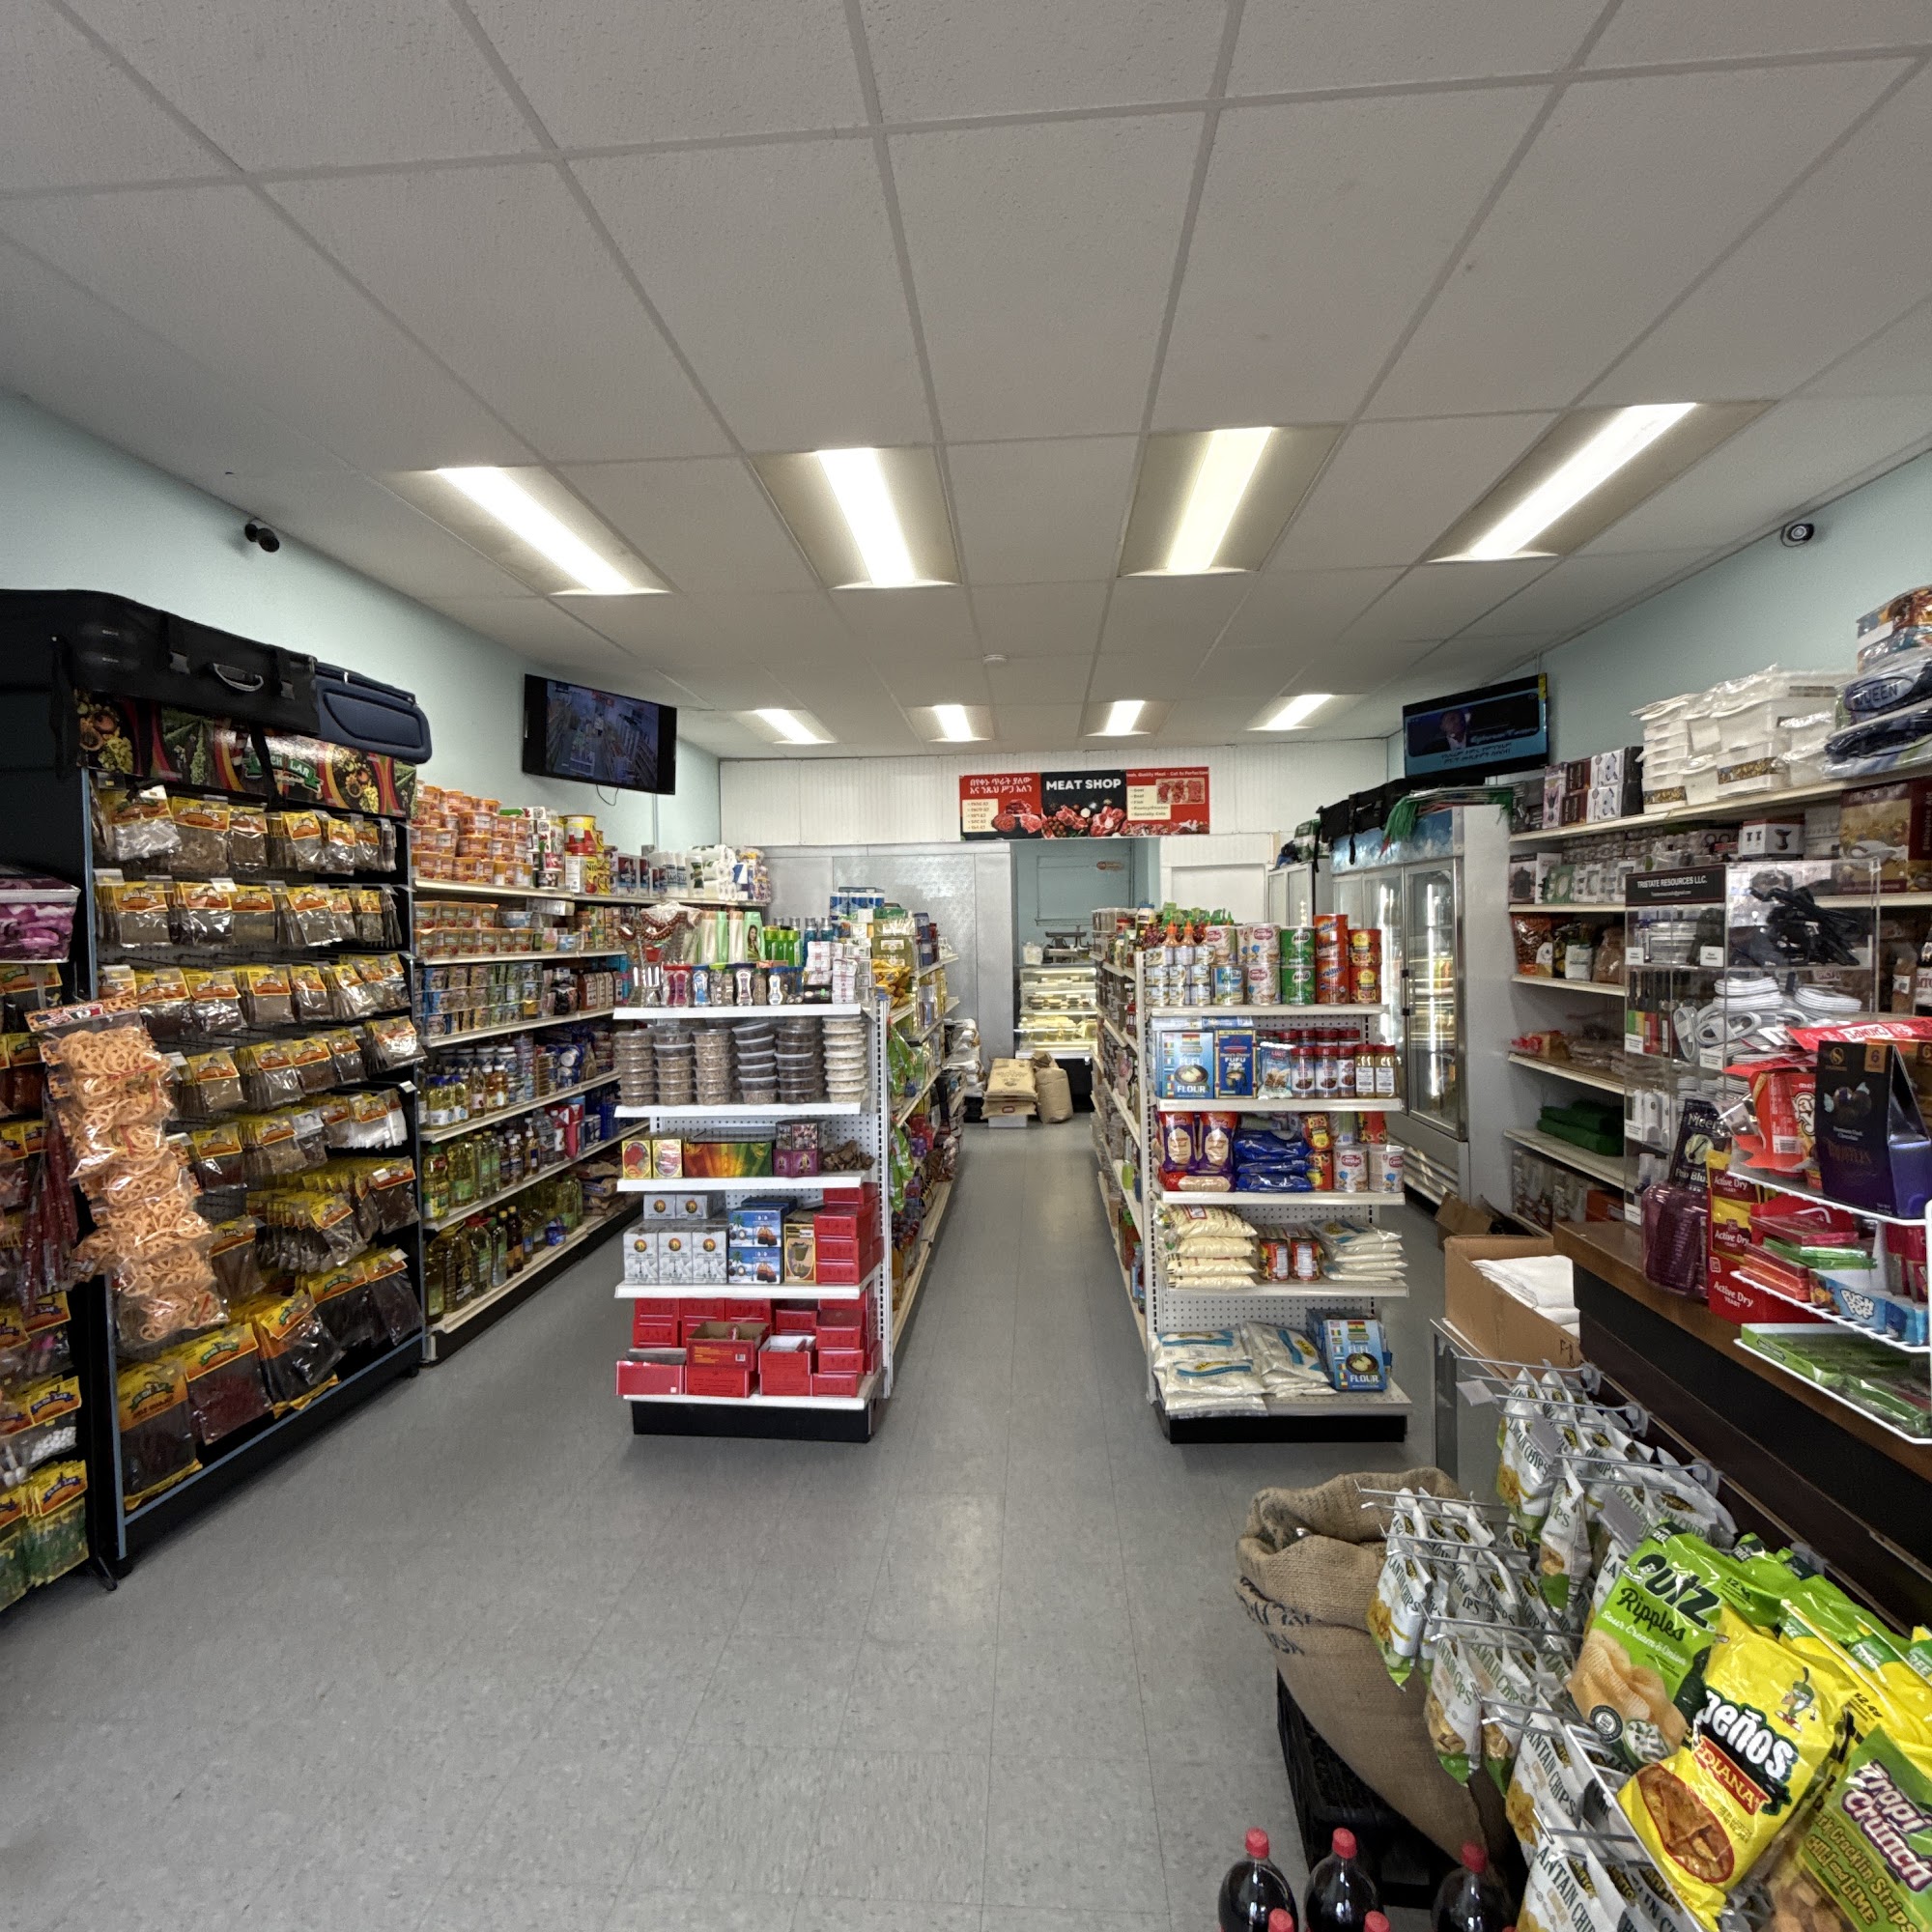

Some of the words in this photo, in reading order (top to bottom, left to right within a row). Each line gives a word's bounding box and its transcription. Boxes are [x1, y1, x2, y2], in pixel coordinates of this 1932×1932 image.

[1046, 781, 1081, 790] MEAT
[1085, 779, 1122, 789] SHOP
[1637, 878, 1660, 889] TRISTATE
[1661, 876, 1693, 887] RESOURCES
[1693, 875, 1708, 885] LLC.
[1871, 1050, 1880, 1062] 6
[1177, 1085, 1206, 1094] FLOUR
[1714, 1176, 1733, 1186] Active
[1734, 1179, 1747, 1190] Dry
[1715, 1230, 1736, 1243] Active
[1736, 1236, 1750, 1247] Dry
[1714, 1281, 1736, 1299] Active
[1737, 1292, 1754, 1307] Dry
[1840, 1289, 1874, 1311] PUSH
[1848, 1301, 1874, 1320] POP
[1350, 1374, 1379, 1383] FLOUR
[1387, 1554, 1407, 1595] LANTAIN
[1617, 1587, 1686, 1641] Ripples
[1602, 1610, 1625, 1631] Sour
[1625, 1625, 1656, 1649] Cream
[1523, 1716, 1552, 1776] LANTAIN
[1548, 1771, 1577, 1818] CHIPS
[1701, 1745, 1756, 1810] DIANA
[1842, 1788, 1932, 1891] Crunch
[1536, 1845, 1578, 1911] ANTAIN
[1831, 1825, 1875, 1883] Cracklin
[1870, 1877, 1918, 1932] Strips
[1830, 1859, 1848, 1880] and
[1839, 1874, 1879, 1926] LIME
